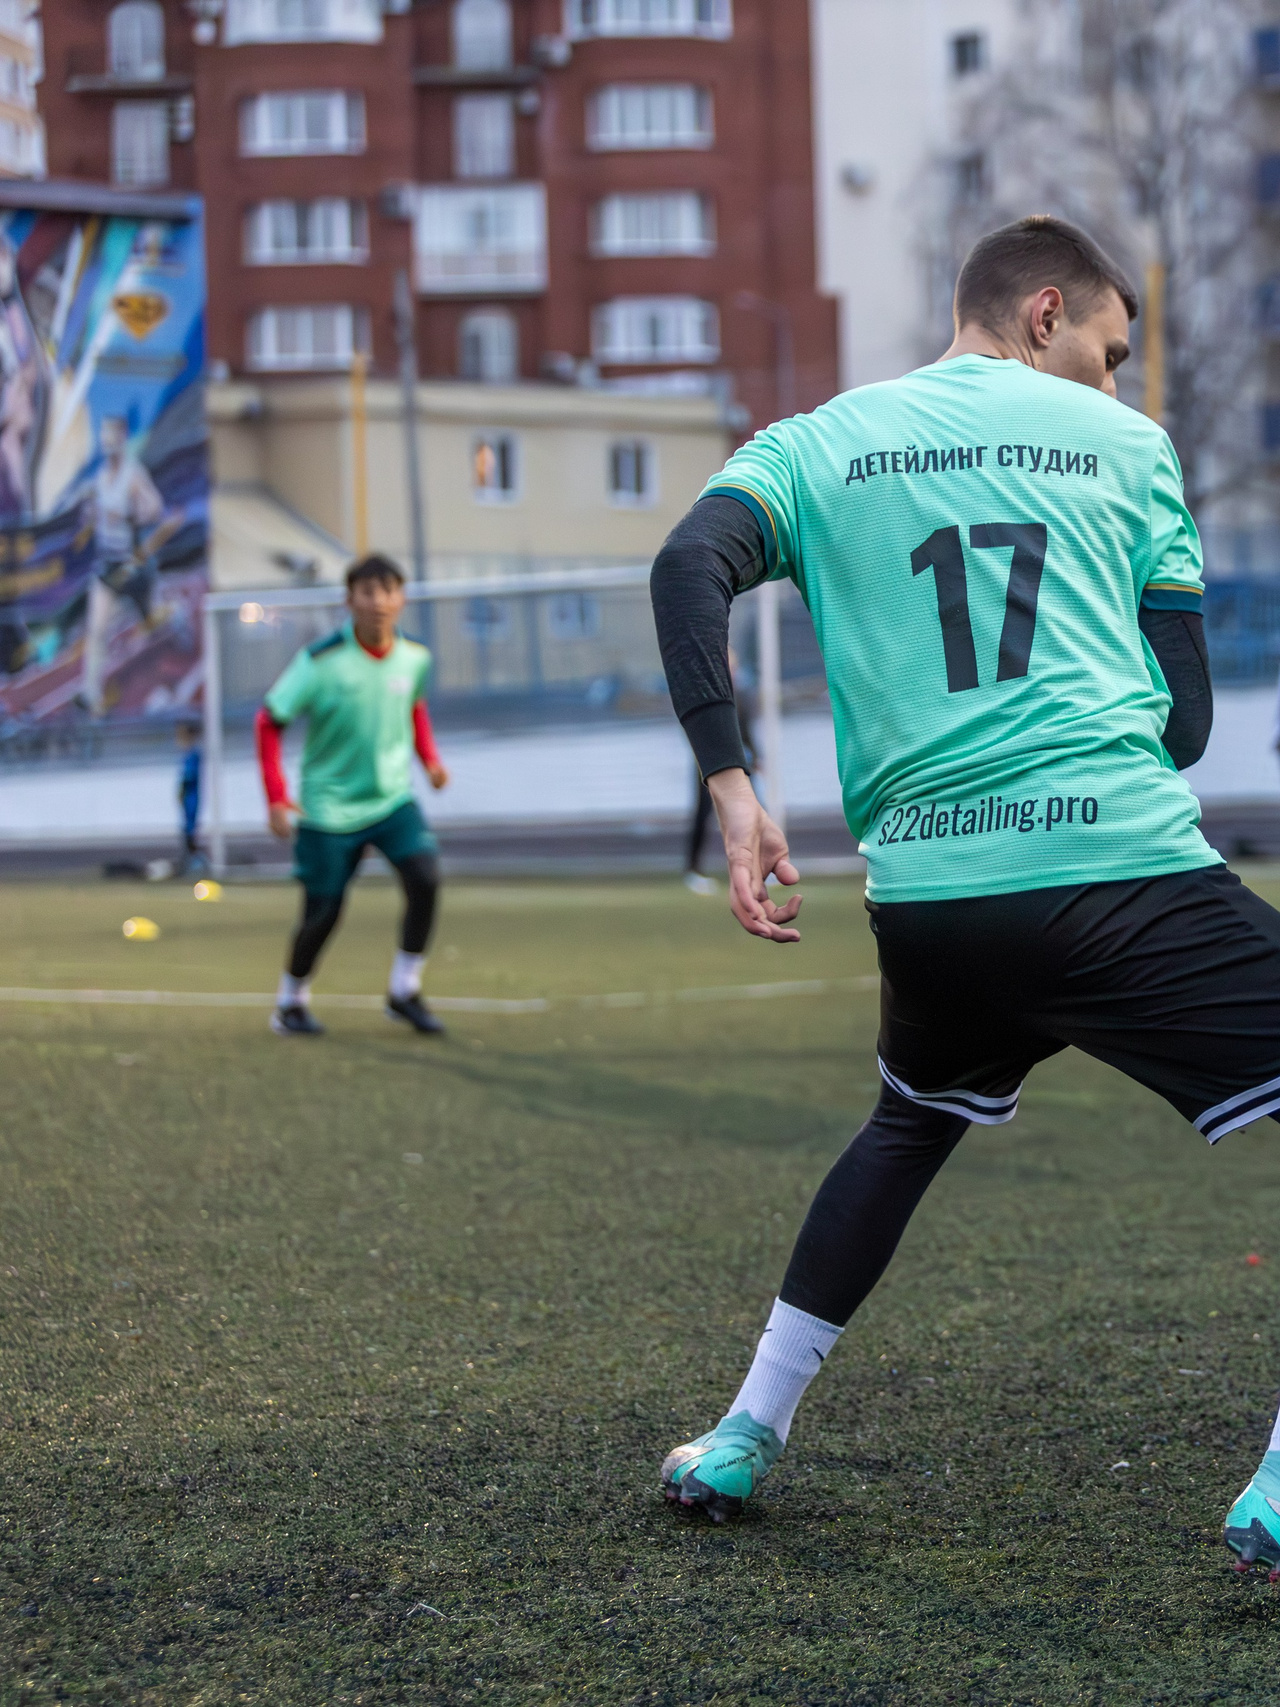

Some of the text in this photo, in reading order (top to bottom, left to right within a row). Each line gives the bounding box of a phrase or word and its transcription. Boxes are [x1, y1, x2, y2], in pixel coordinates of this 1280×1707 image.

[845, 444, 1098, 486] ДЕТЕЙЛИНГ СТУДИЯ
[910, 522, 1047, 693] 17
[878, 796, 1099, 847] s22detailing.pro
